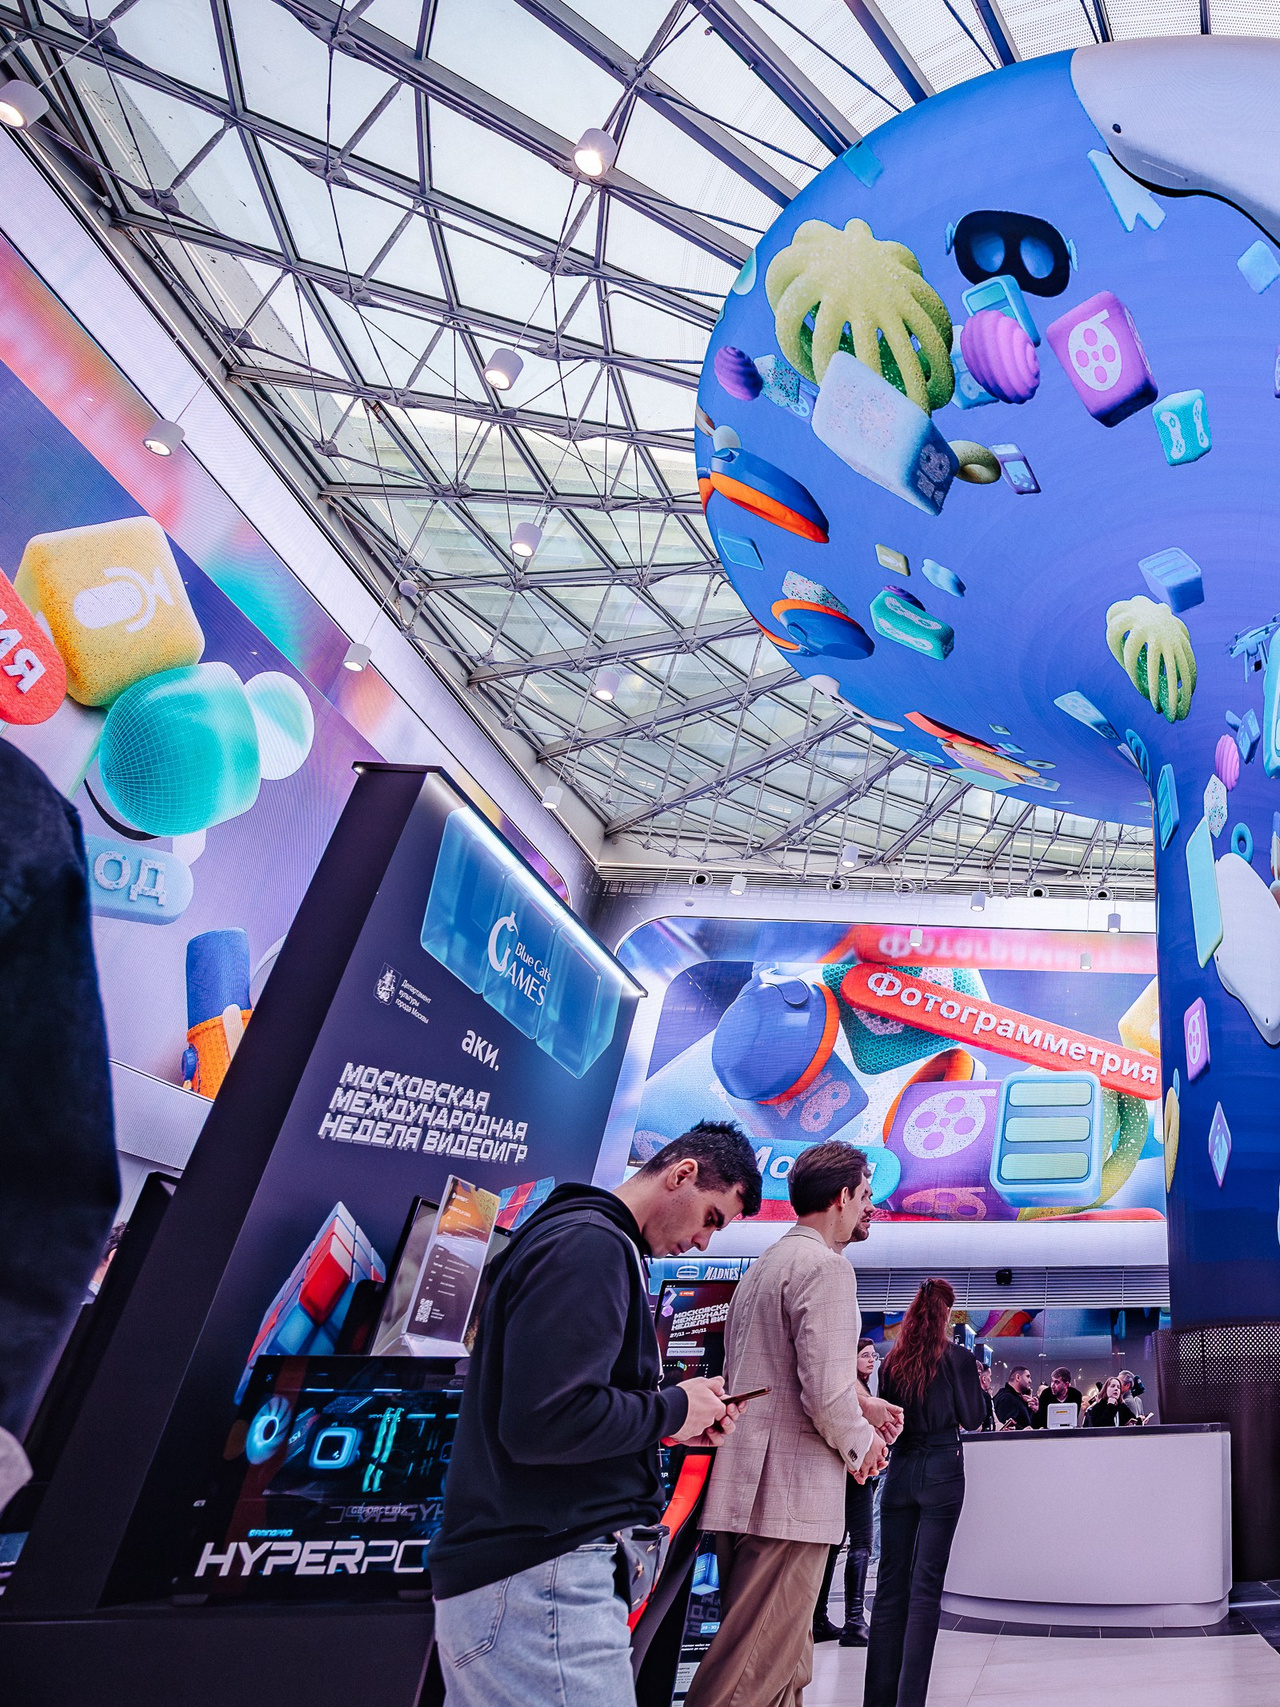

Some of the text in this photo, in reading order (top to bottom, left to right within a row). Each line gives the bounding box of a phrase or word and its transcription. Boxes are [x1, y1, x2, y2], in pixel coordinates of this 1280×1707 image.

[92, 850, 168, 907] ОД
[515, 942, 552, 983] Blue Cats
[867, 972, 1158, 1085] Фотограмметрия
[339, 1062, 490, 1114] МОСКОВСКАЯ
[318, 1112, 528, 1165] НЕДЕЛЯ ВИДЕОИГР
[328, 1087, 528, 1142] МЕЖДУНАРОДНАЯ
[673, 1309, 729, 1326] МЕЖДУНАРО
[674, 1302, 730, 1320] МОСКОВСКА
[194, 1540, 430, 1577] HYPERPC
